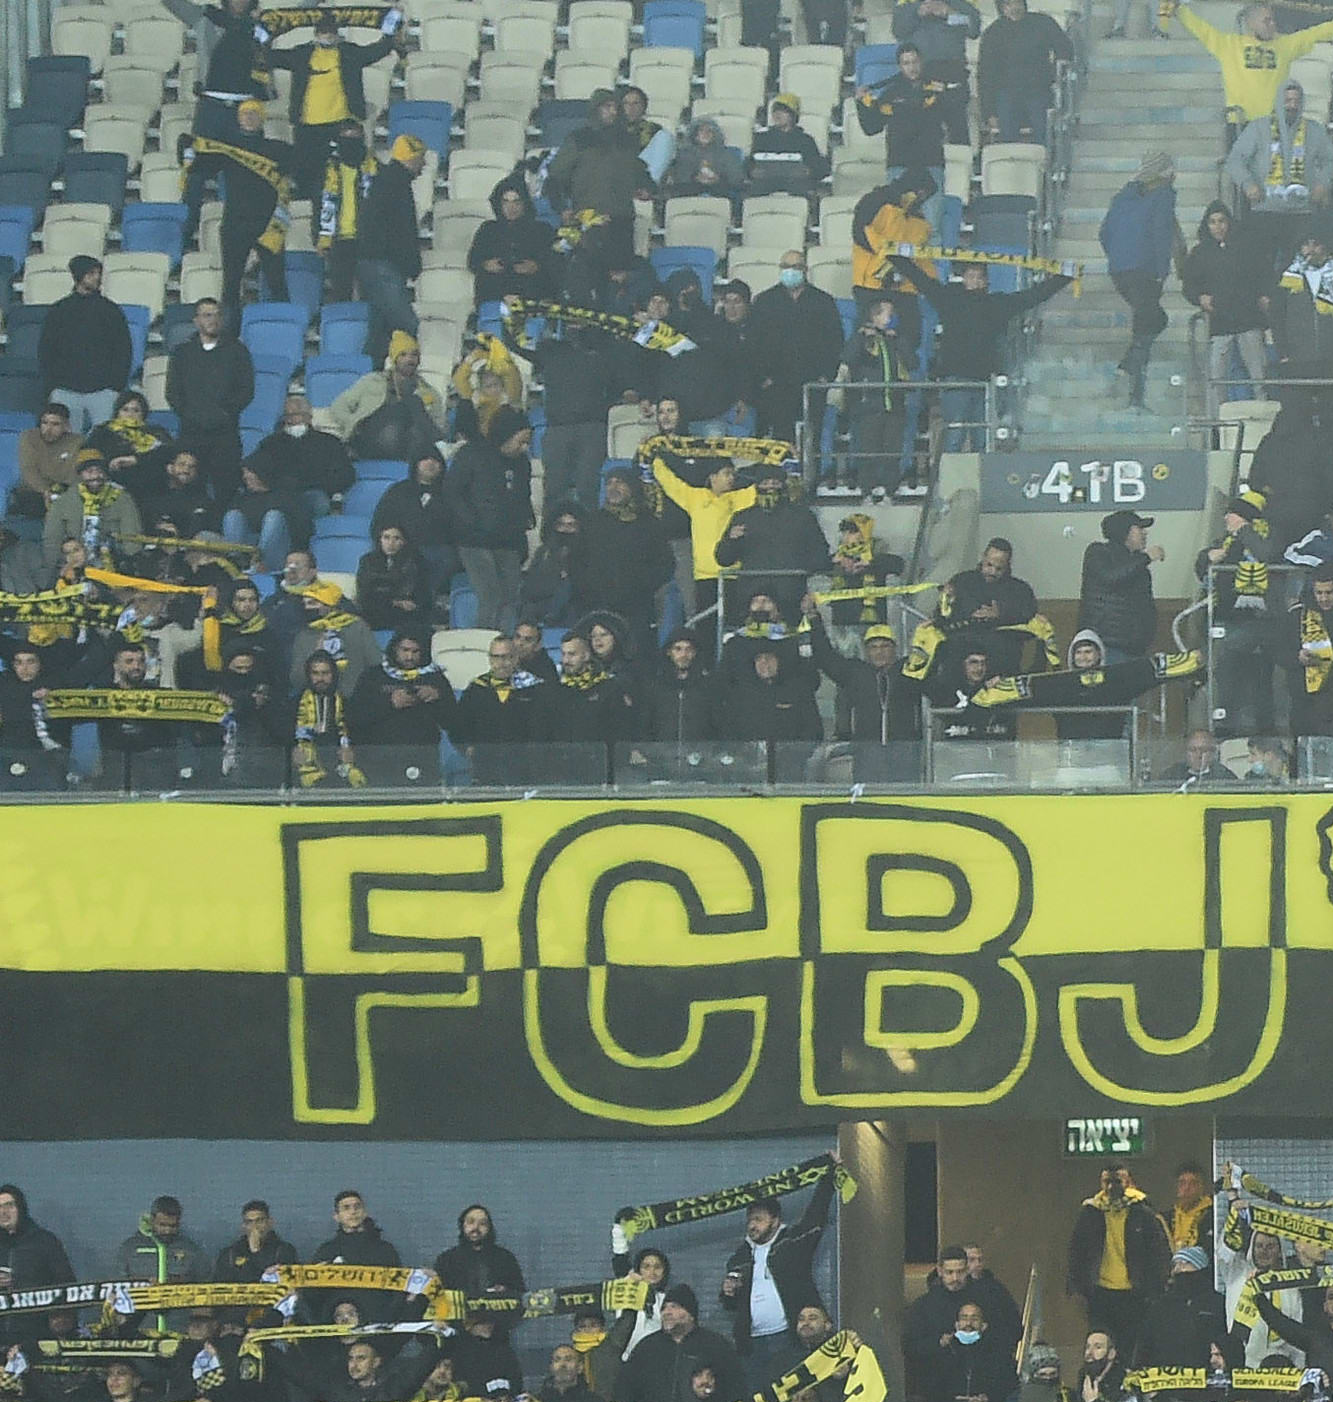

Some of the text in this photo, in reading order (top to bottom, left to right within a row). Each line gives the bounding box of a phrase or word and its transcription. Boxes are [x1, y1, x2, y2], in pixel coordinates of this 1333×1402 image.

[1041, 459, 1146, 502] 41B
[281, 803, 1287, 1127] FCBJ
[1067, 1118, 1139, 1151] יציאה
